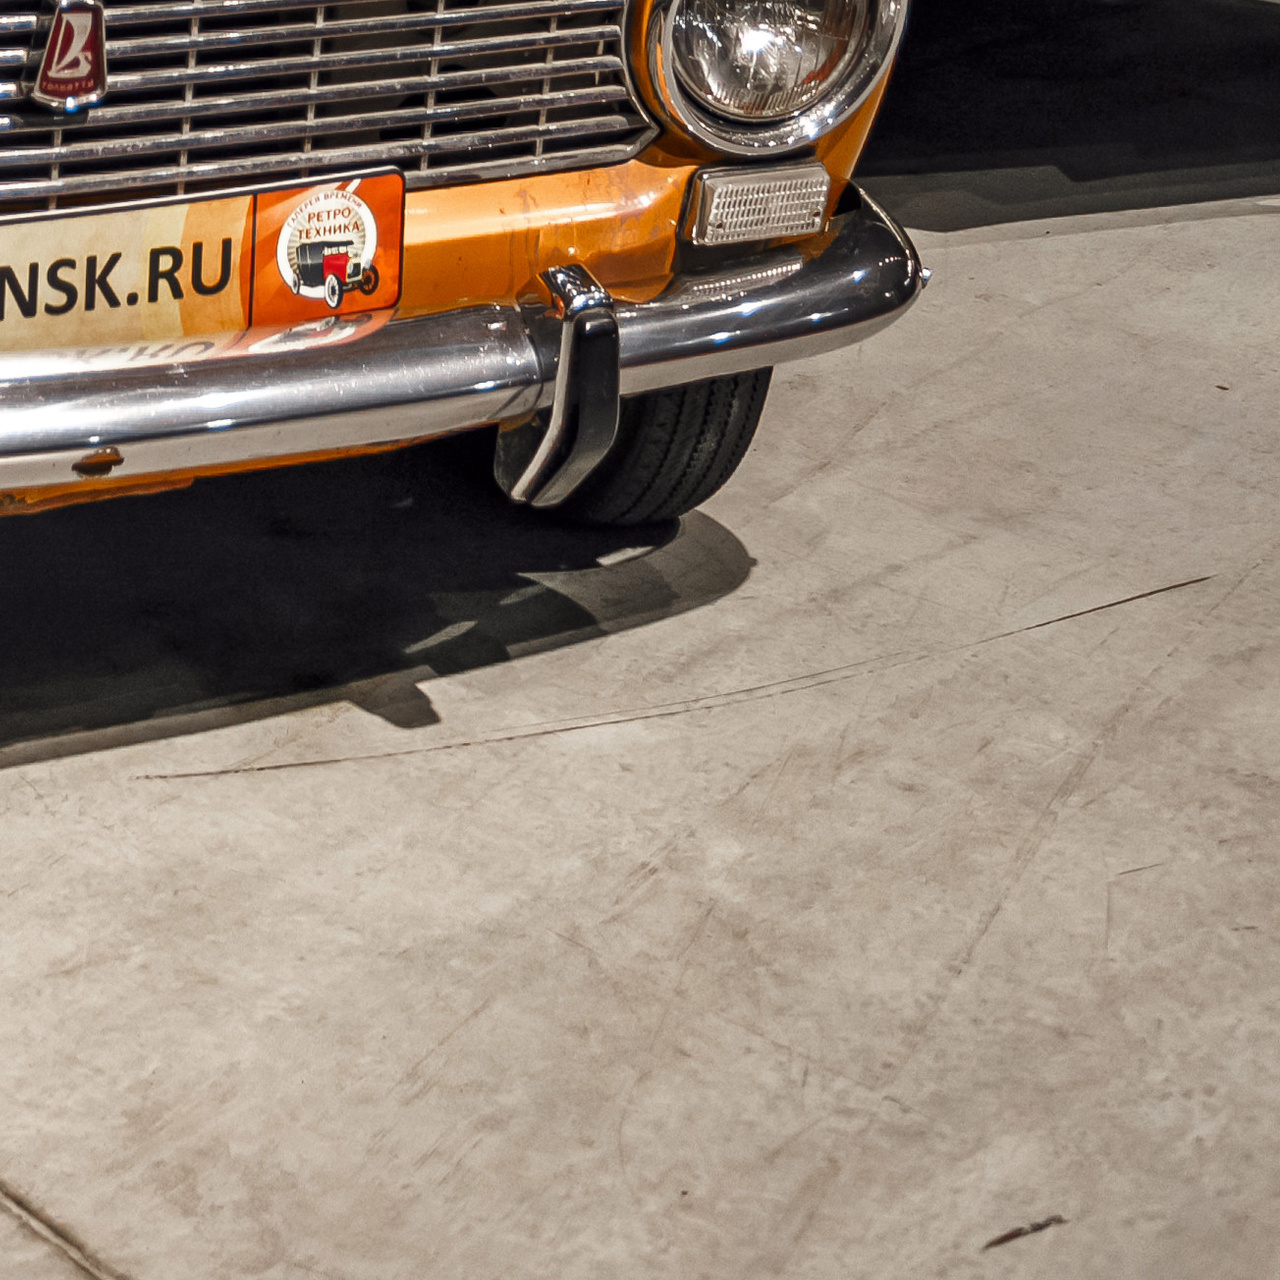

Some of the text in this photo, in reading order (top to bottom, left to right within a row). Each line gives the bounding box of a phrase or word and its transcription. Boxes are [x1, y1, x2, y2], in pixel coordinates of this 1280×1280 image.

[287, 191, 363, 228] ГАЛЕРЕЯ ВРЕМЕНИ
[307, 206, 352, 224] РЕТРО
[297, 220, 361, 240] ТЕХНИКА
